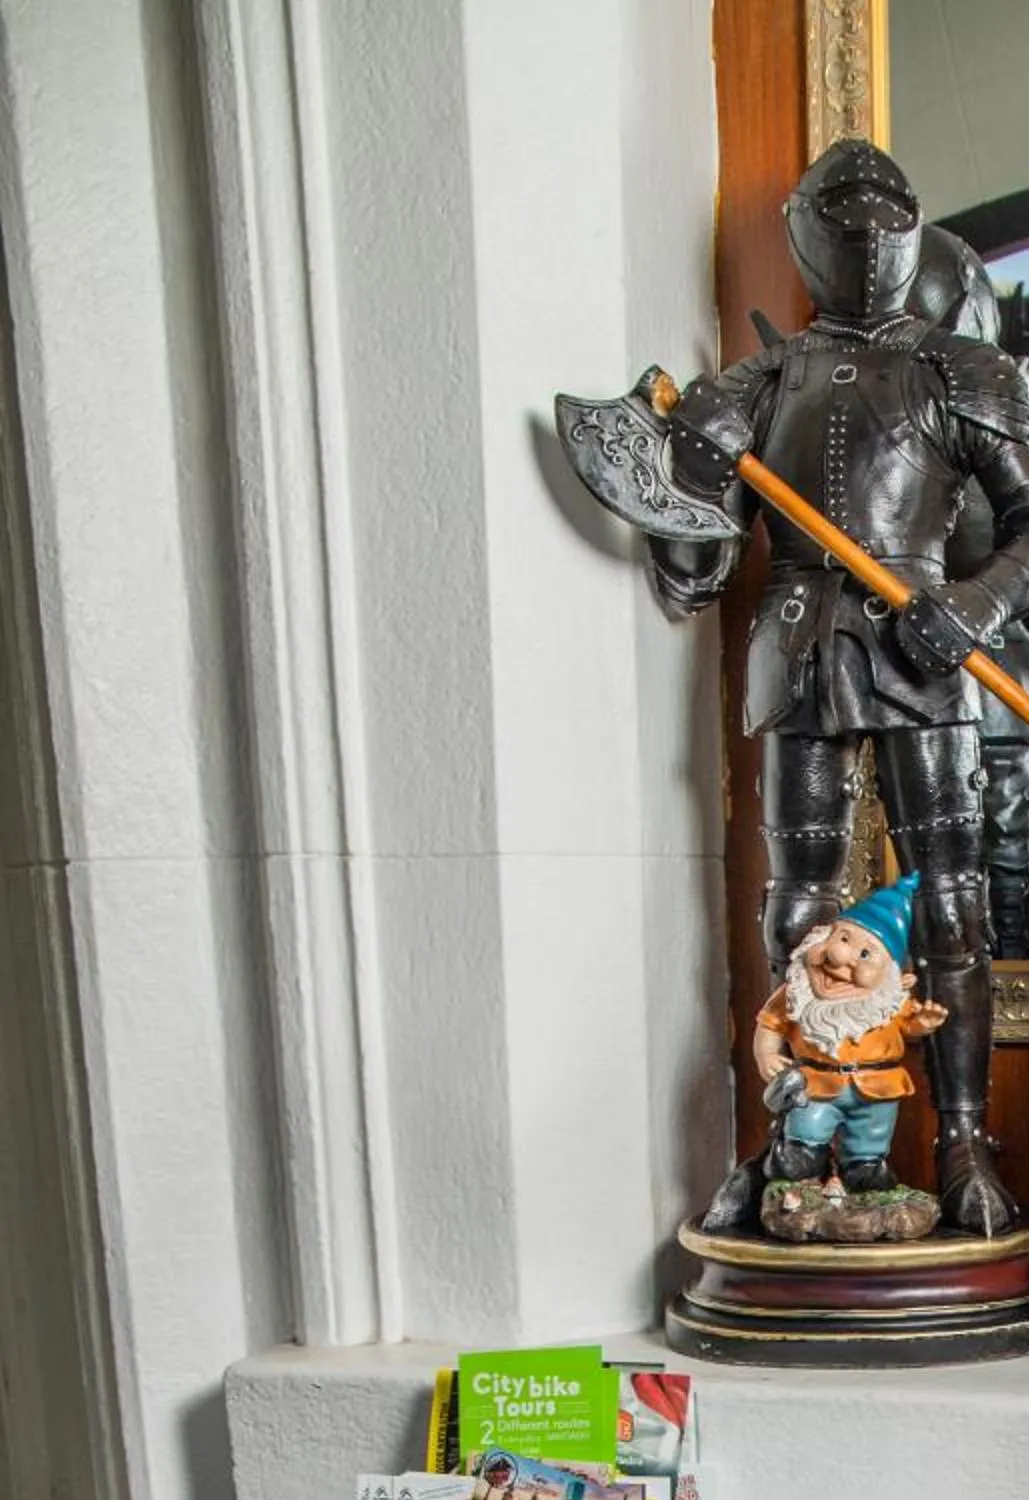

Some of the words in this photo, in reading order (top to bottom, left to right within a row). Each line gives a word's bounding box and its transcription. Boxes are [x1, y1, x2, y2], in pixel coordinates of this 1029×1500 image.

[472, 1372, 525, 1398] City
[529, 1375, 580, 1397] bike
[494, 1396, 557, 1418] Tours
[480, 1420, 495, 1445] 2
